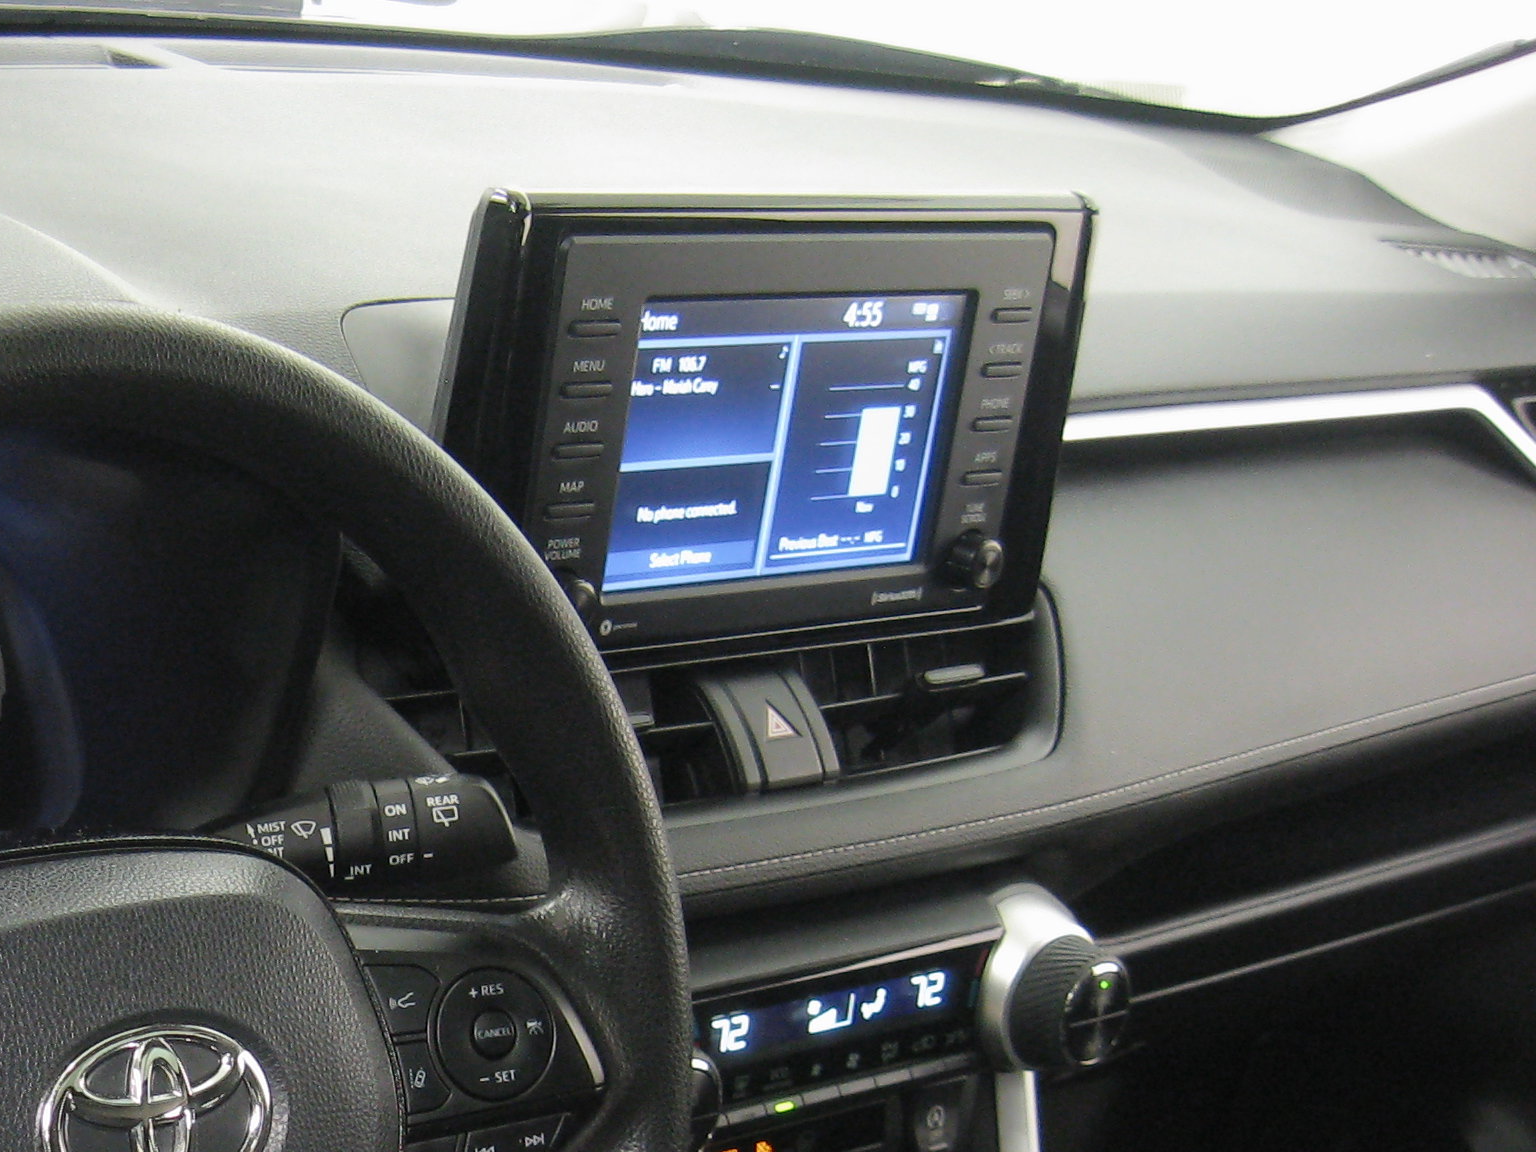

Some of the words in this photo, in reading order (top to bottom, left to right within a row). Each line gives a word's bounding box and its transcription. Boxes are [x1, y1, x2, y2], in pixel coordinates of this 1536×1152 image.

[581, 298, 614, 311] HOME
[843, 301, 885, 328] 4:55
[573, 359, 606, 373] MENU
[651, 357, 673, 374] FM
[564, 420, 599, 434] AUDIO
[559, 481, 585, 494] MAP
[547, 538, 581, 550] POWER
[544, 549, 581, 562] VOLUME
[426, 794, 459, 807] REAR
[384, 803, 407, 817] ON
[257, 821, 286, 833] MIST
[261, 835, 284, 847] OFF
[388, 829, 411, 842] INT
[389, 853, 414, 865] OFF
[350, 864, 372, 876] INT
[911, 971, 946, 1008] 72
[476, 1024, 513, 1039] CANCEL
[711, 1013, 750, 1053] 72
